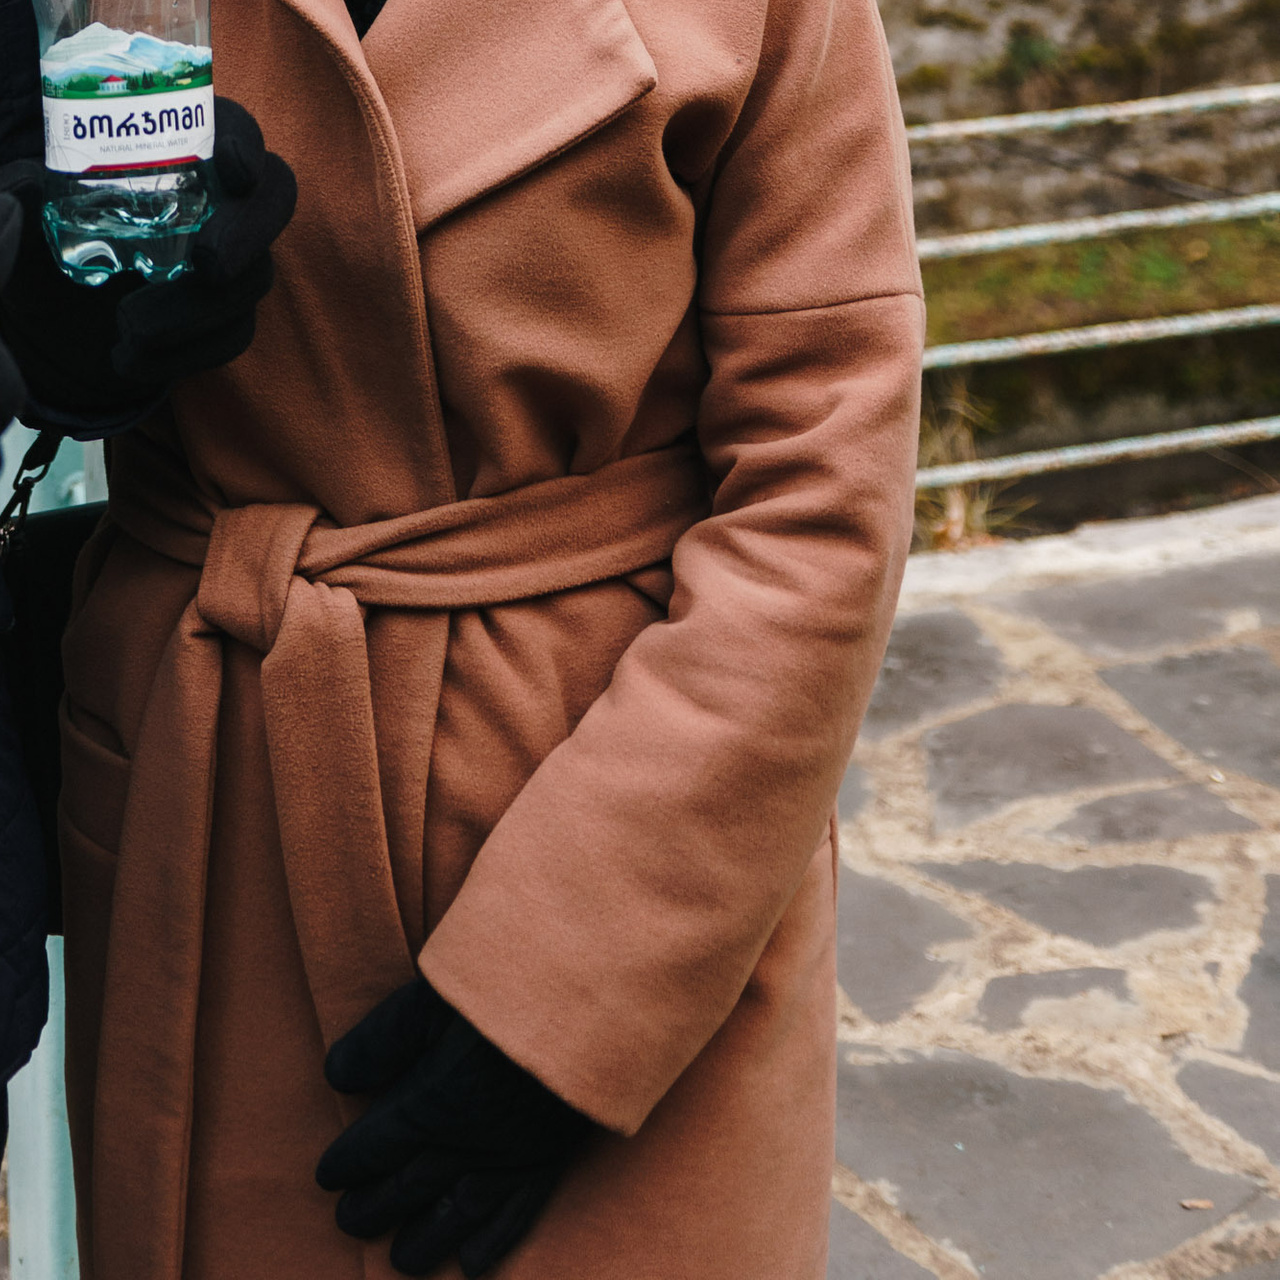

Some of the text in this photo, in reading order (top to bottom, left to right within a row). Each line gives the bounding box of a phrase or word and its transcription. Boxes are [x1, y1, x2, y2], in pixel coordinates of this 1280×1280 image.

[73, 104, 205, 140] ბორჯომი
[100, 136, 189, 154] NATURAL MINERAL WATER
